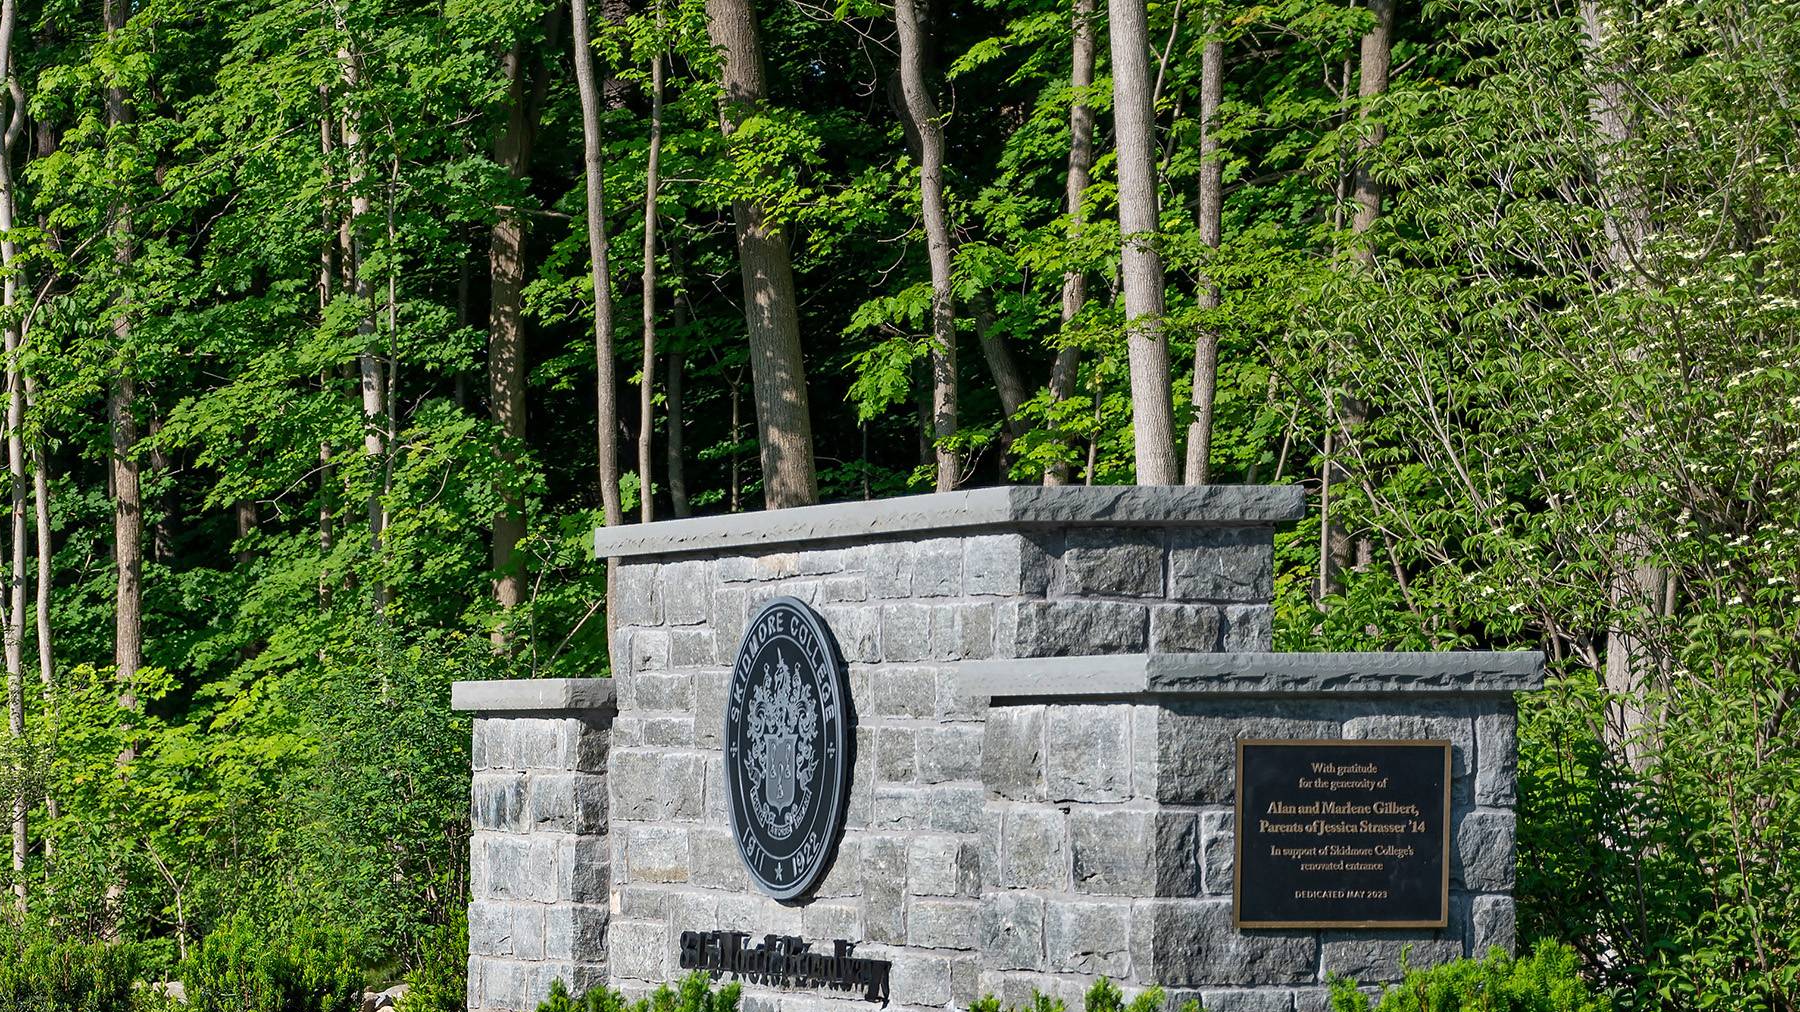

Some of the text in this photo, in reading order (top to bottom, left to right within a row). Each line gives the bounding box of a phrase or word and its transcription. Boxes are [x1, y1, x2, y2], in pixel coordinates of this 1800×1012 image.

[731, 612, 835, 724] SKIDMORE COLLEGE
[1311, 762, 1378, 776] With gratitude
[1298, 777, 1388, 791] for the generosity of
[1266, 801, 1420, 816] Alan and Marlene Gilbert,
[1259, 819, 1426, 836] Parents of Jessica Strasser '14
[792, 831, 820, 878] 1922
[1270, 845, 1414, 859] In support of Skidmore College's
[1300, 860, 1384, 871] renovated entrance
[1295, 890, 1388, 899] DEDICATED MAY 2023
